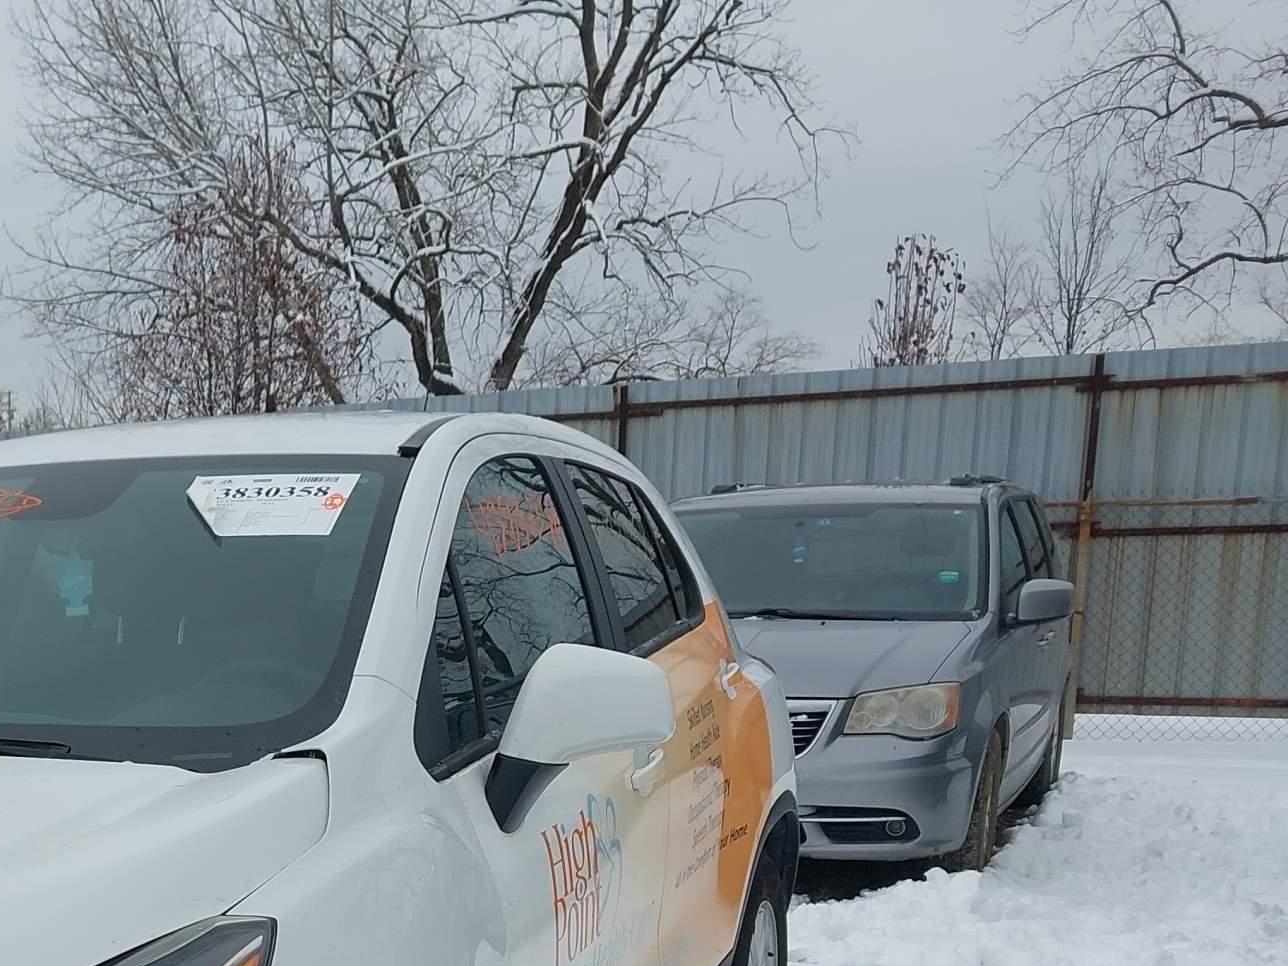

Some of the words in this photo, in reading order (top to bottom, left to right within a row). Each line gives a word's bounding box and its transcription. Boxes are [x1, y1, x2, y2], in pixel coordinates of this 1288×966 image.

[214, 485, 331, 500] 3830358
[729, 824, 748, 845] Home
[540, 808, 599, 902] High
